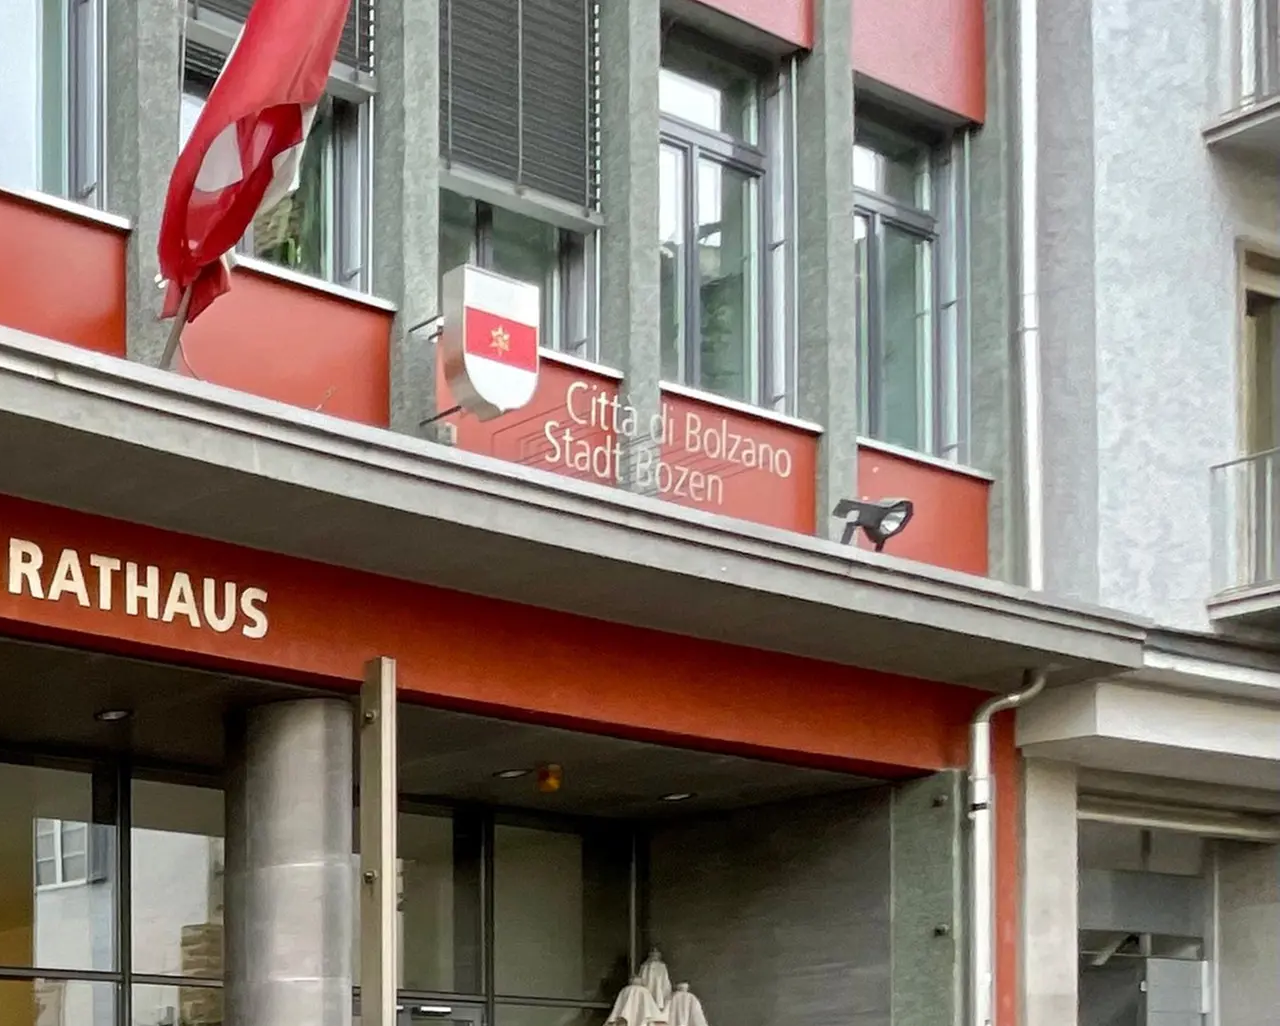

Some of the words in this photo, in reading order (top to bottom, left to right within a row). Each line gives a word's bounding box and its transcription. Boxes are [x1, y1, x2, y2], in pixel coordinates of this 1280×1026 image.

[543, 420, 624, 482] Stadt
[635, 446, 723, 505] Bozen
[566, 381, 638, 437] Città
[650, 402, 675, 447] di
[685, 411, 793, 478] Bolzano
[8, 536, 269, 639] RATHAUS
